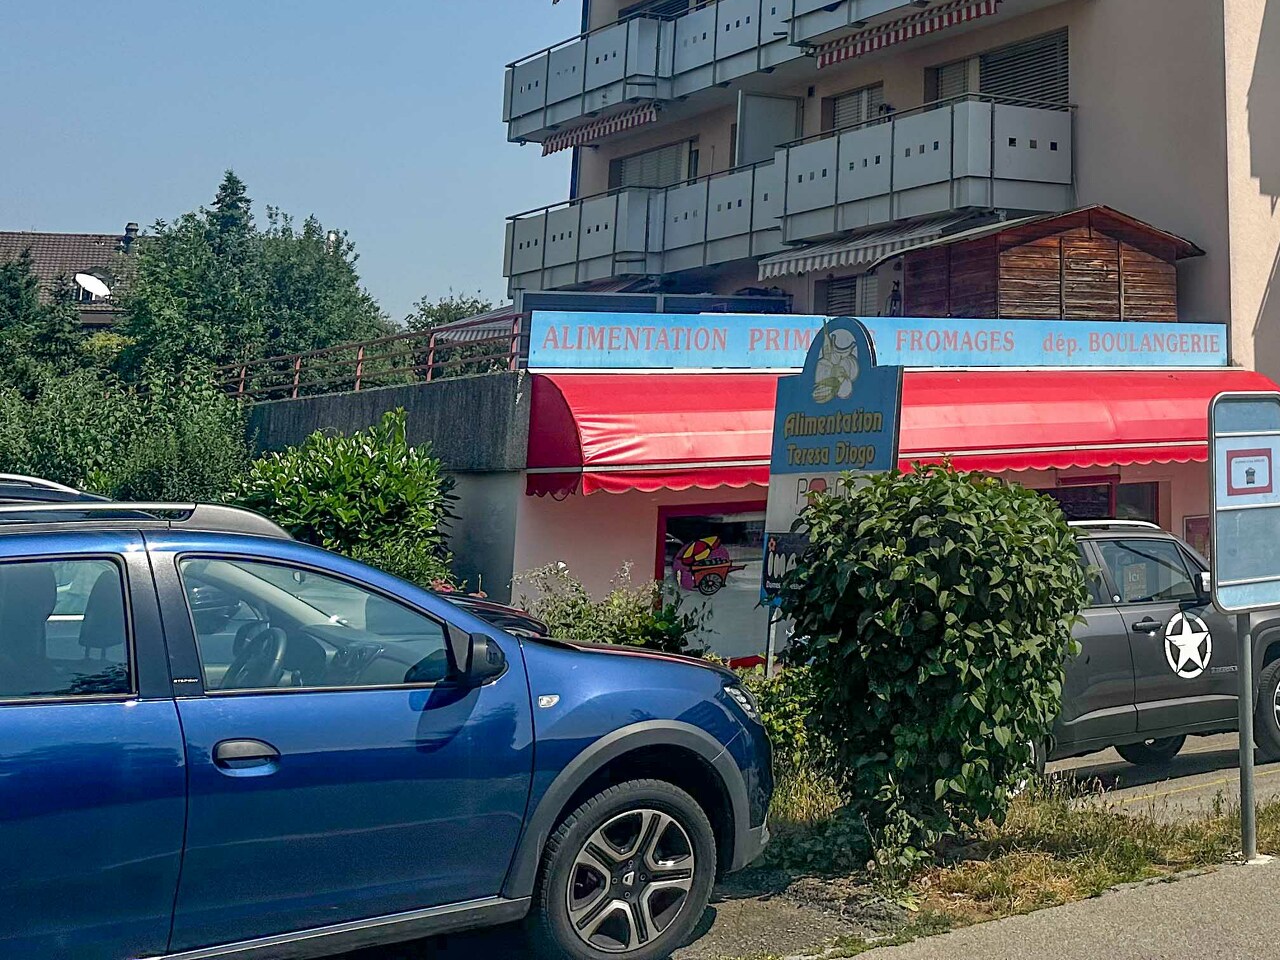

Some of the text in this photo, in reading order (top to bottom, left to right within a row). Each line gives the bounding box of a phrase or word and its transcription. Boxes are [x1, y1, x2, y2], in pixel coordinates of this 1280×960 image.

[542, 325, 728, 351] ALIMENTATION
[895, 329, 1015, 352] FROMAGES
[1042, 330, 1083, 357] dép.
[1088, 332, 1221, 354] BOULANGERIE
[784, 407, 883, 440] Alimentation
[787, 440, 876, 468] Teresa Diogo
